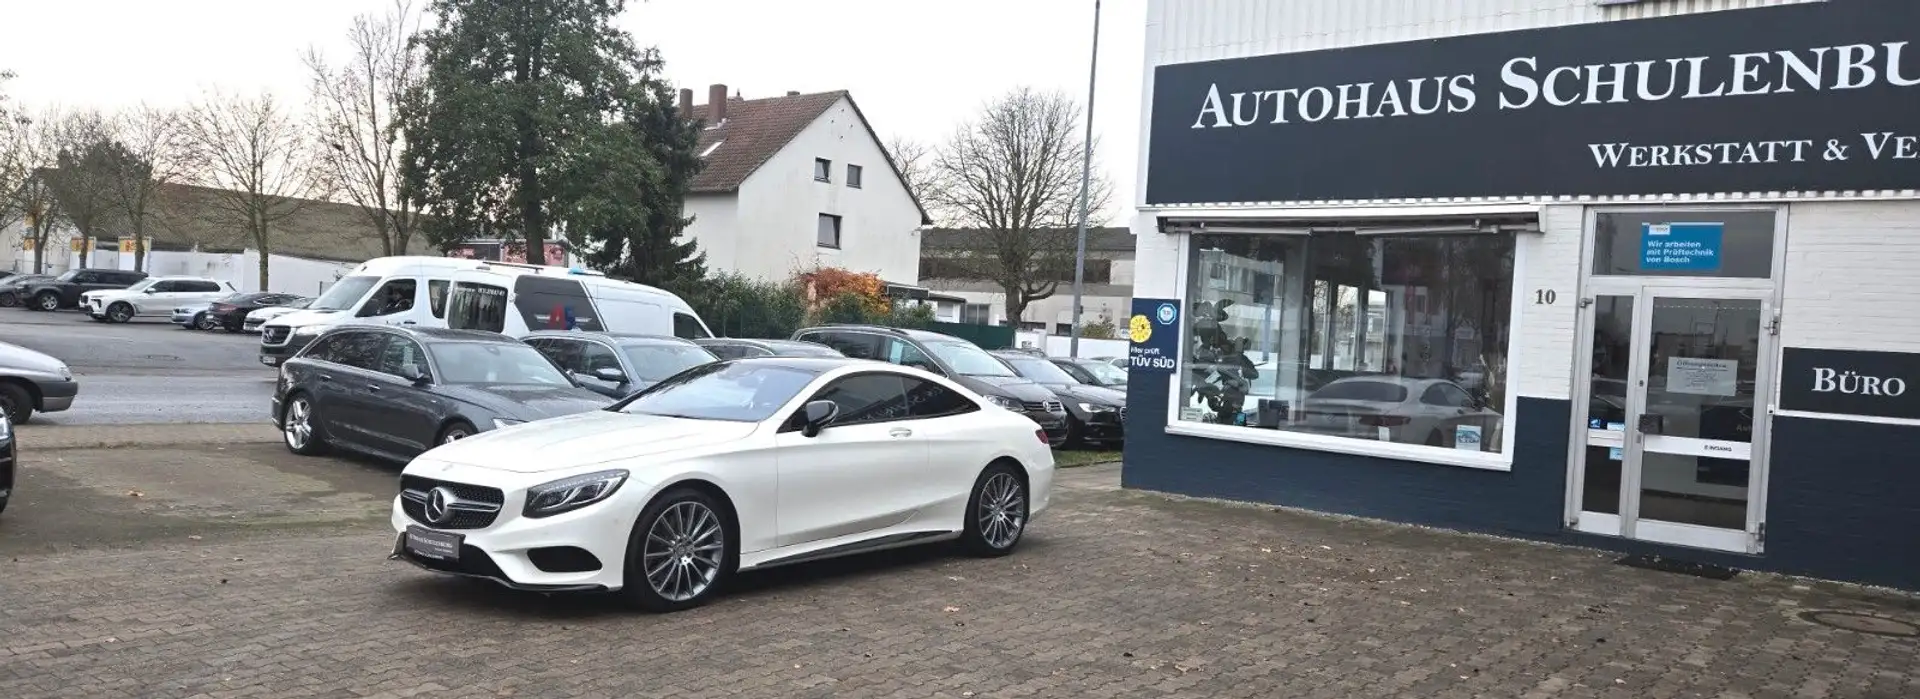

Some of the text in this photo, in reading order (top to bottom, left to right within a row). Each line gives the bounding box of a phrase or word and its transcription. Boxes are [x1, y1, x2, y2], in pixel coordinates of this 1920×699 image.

[1191, 73, 1477, 129] AUTOHAUS
[1588, 139, 1813, 168] WERKSTATT
[1822, 139, 1849, 161] &
[1646, 248, 1715, 256] mit Prüftechnik
[1647, 240, 1701, 248] Wir arbeiten
[1535, 288, 1557, 305] 10
[1130, 346, 1161, 356] Hier prüft
[1130, 354, 1176, 369] TÜV SÜD
[1811, 367, 1906, 397] BÜRO
